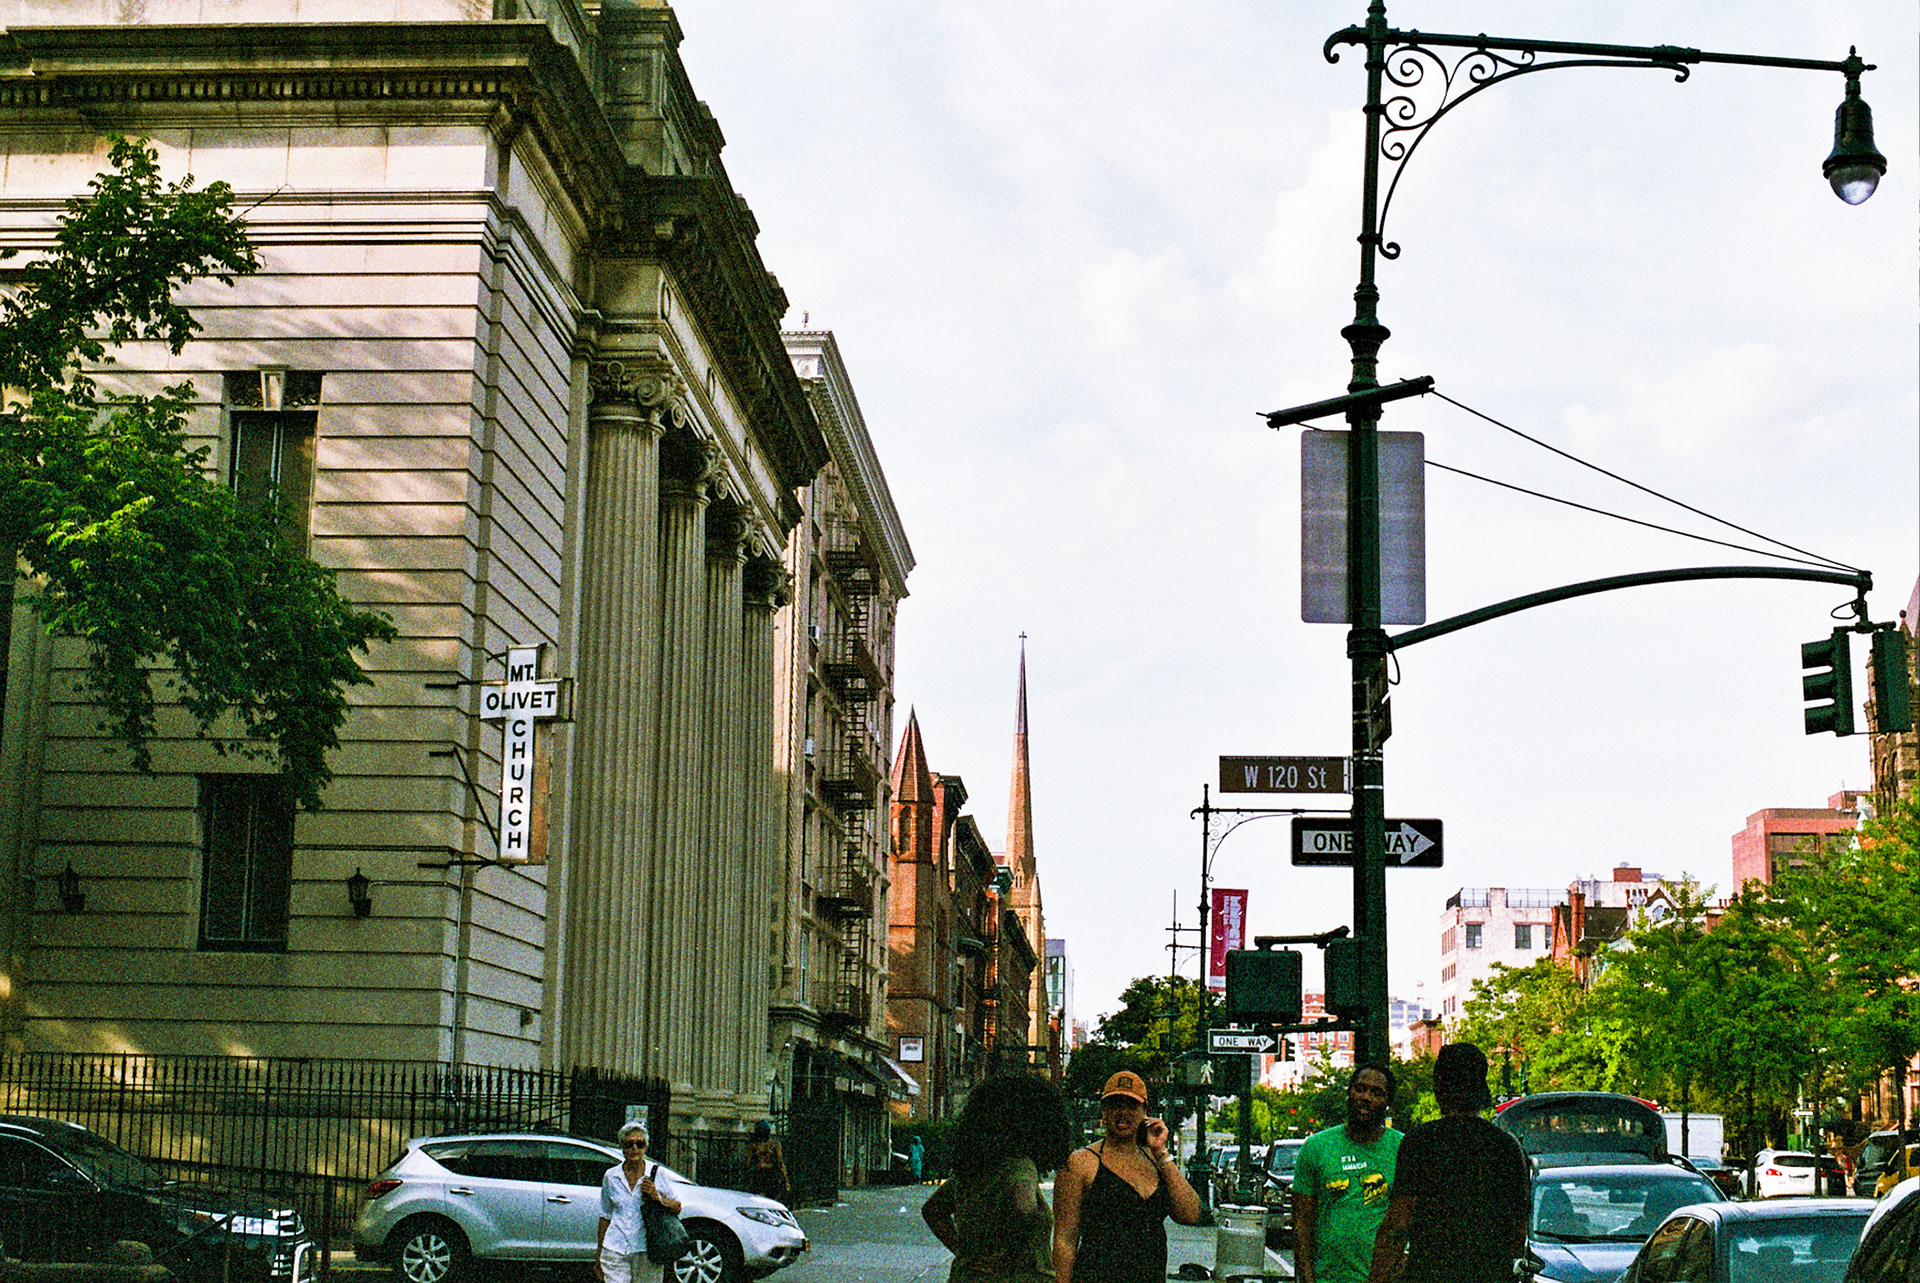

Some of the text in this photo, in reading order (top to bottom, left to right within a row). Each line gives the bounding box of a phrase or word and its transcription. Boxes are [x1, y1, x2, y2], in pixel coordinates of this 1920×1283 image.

[510, 664, 534, 682] MT.
[486, 691, 556, 711] OLIVET
[507, 720, 527, 848] CHURCH
[1244, 765, 1328, 789] W 120 St
[1314, 833, 1354, 852] ONE
[1218, 1036, 1268, 1047] ONE WAY
